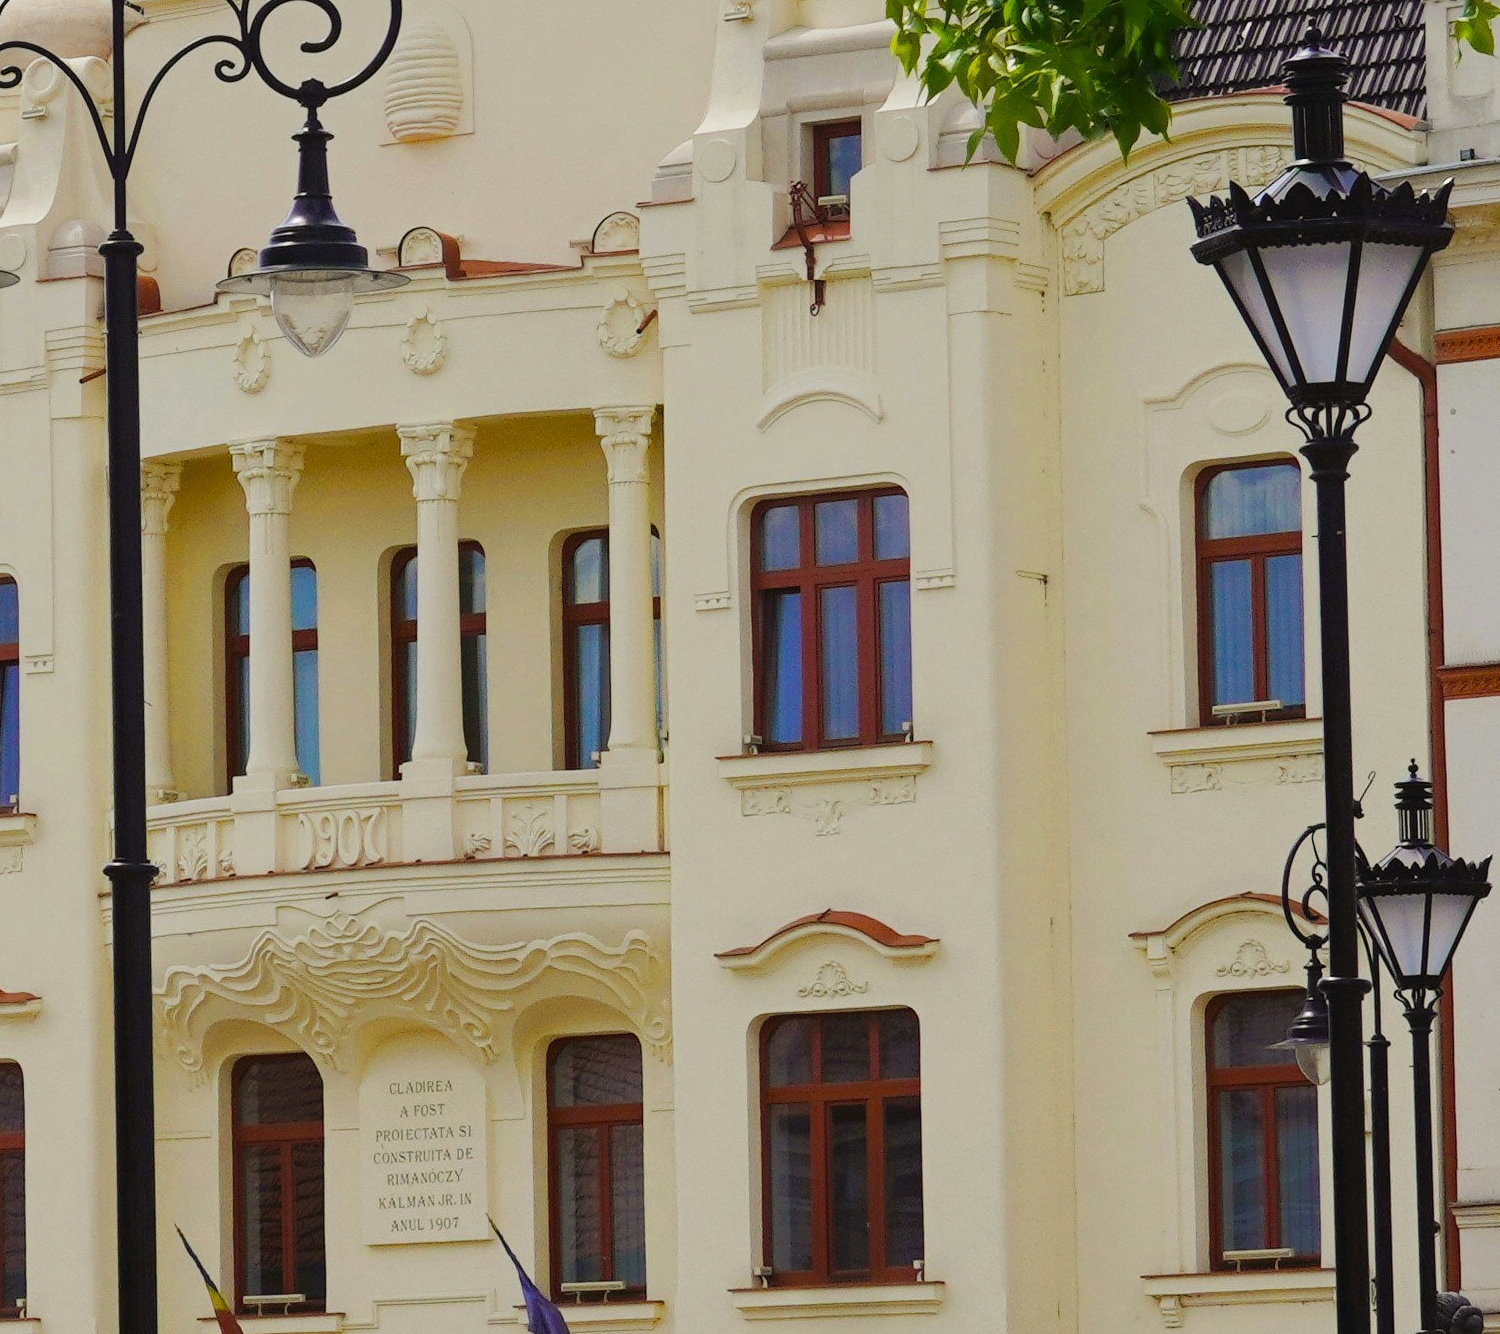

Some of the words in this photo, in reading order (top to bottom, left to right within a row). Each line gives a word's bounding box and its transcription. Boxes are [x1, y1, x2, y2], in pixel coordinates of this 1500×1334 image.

[299, 807, 384, 870] 1907
[389, 1080, 453, 1095] CLADIREA
[400, 1106, 409, 1117] A
[414, 1103, 445, 1117] FOST
[375, 1126, 455, 1142] PROIECTATA
[458, 1125, 472, 1138] SI
[373, 1148, 451, 1164] CONSTRUITA
[456, 1147, 474, 1160] DE
[387, 1168, 464, 1186] RIMANÓCZY
[438, 1193, 457, 1206] JR.
[459, 1192, 472, 1205] IN
[390, 1219, 425, 1232] ANUL
[429, 1217, 460, 1231] 1907
